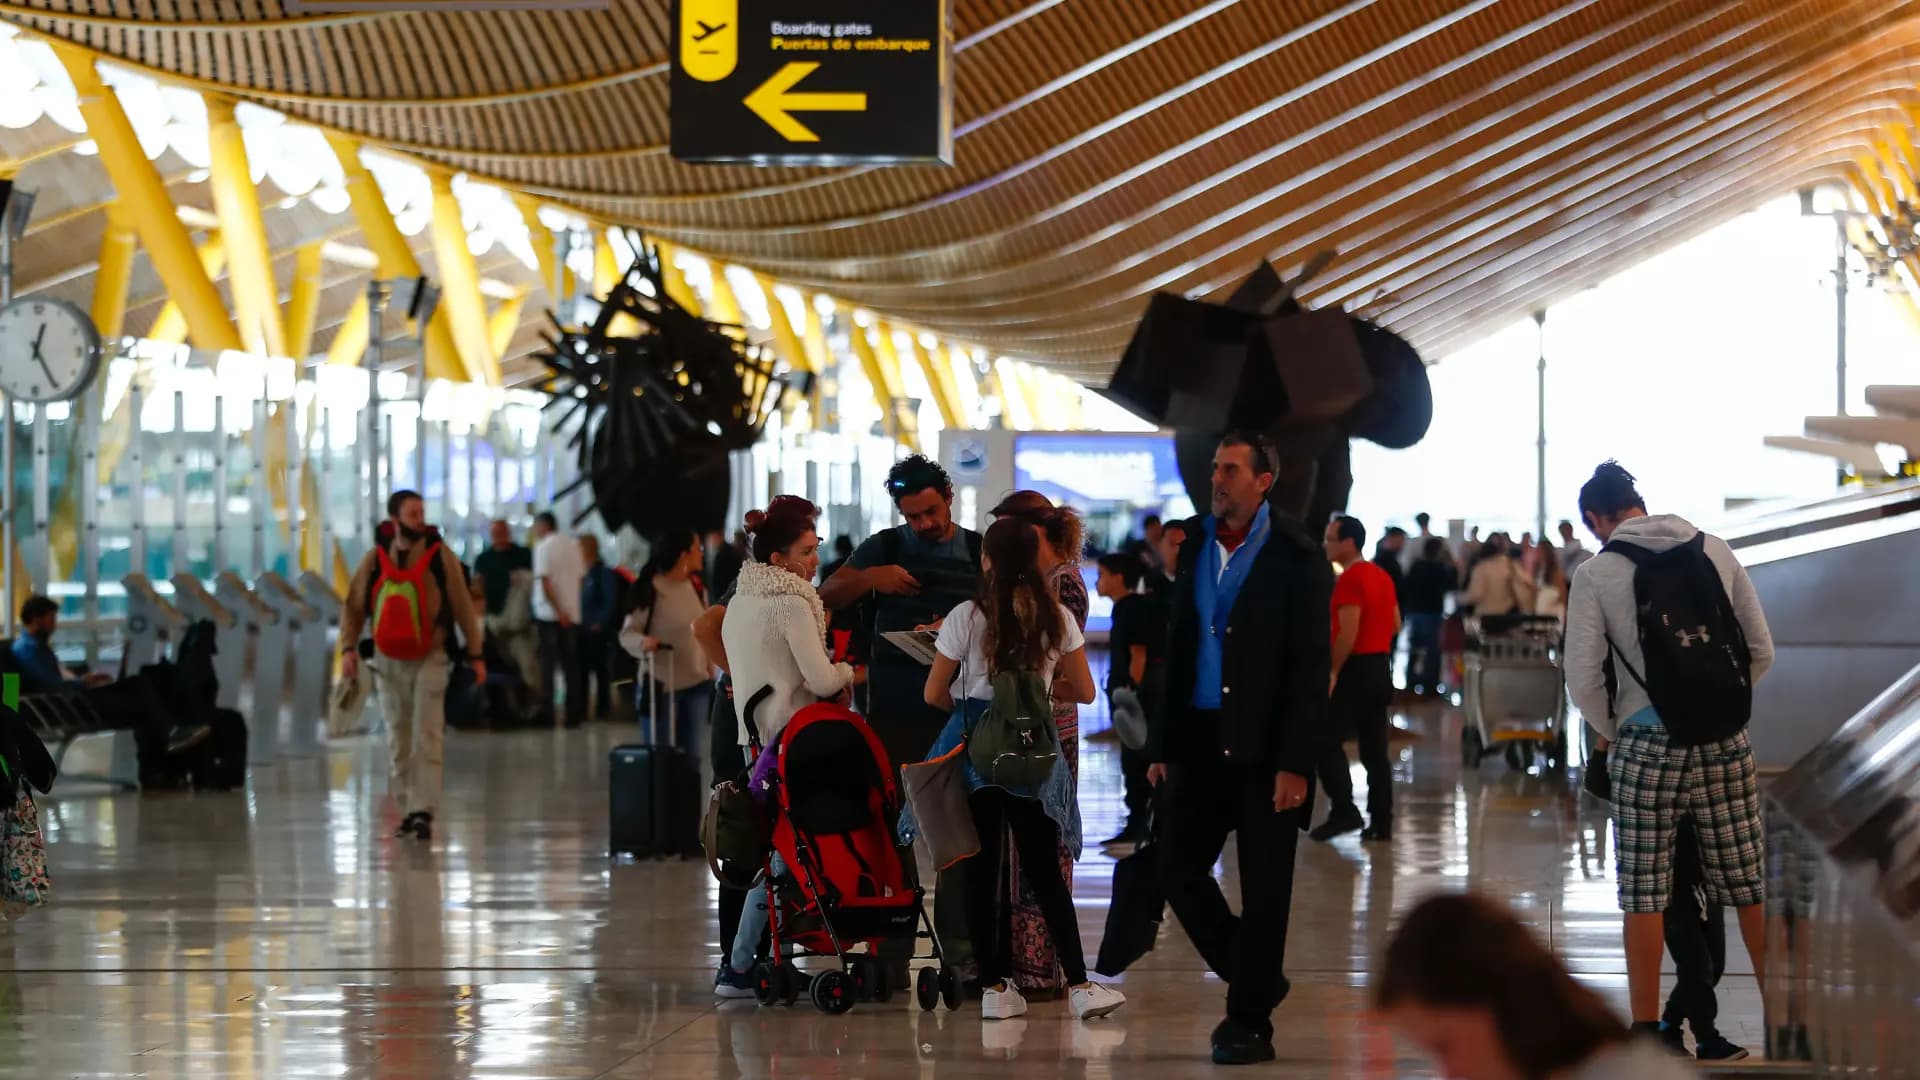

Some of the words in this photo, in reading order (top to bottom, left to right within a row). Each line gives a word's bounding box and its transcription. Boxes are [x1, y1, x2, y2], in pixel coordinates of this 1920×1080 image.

[771, 22, 830, 37] Boarding
[834, 23, 872, 37] gates
[771, 38, 829, 50] Puertas
[832, 38, 851, 50] de
[854, 38, 931, 52] embarque
